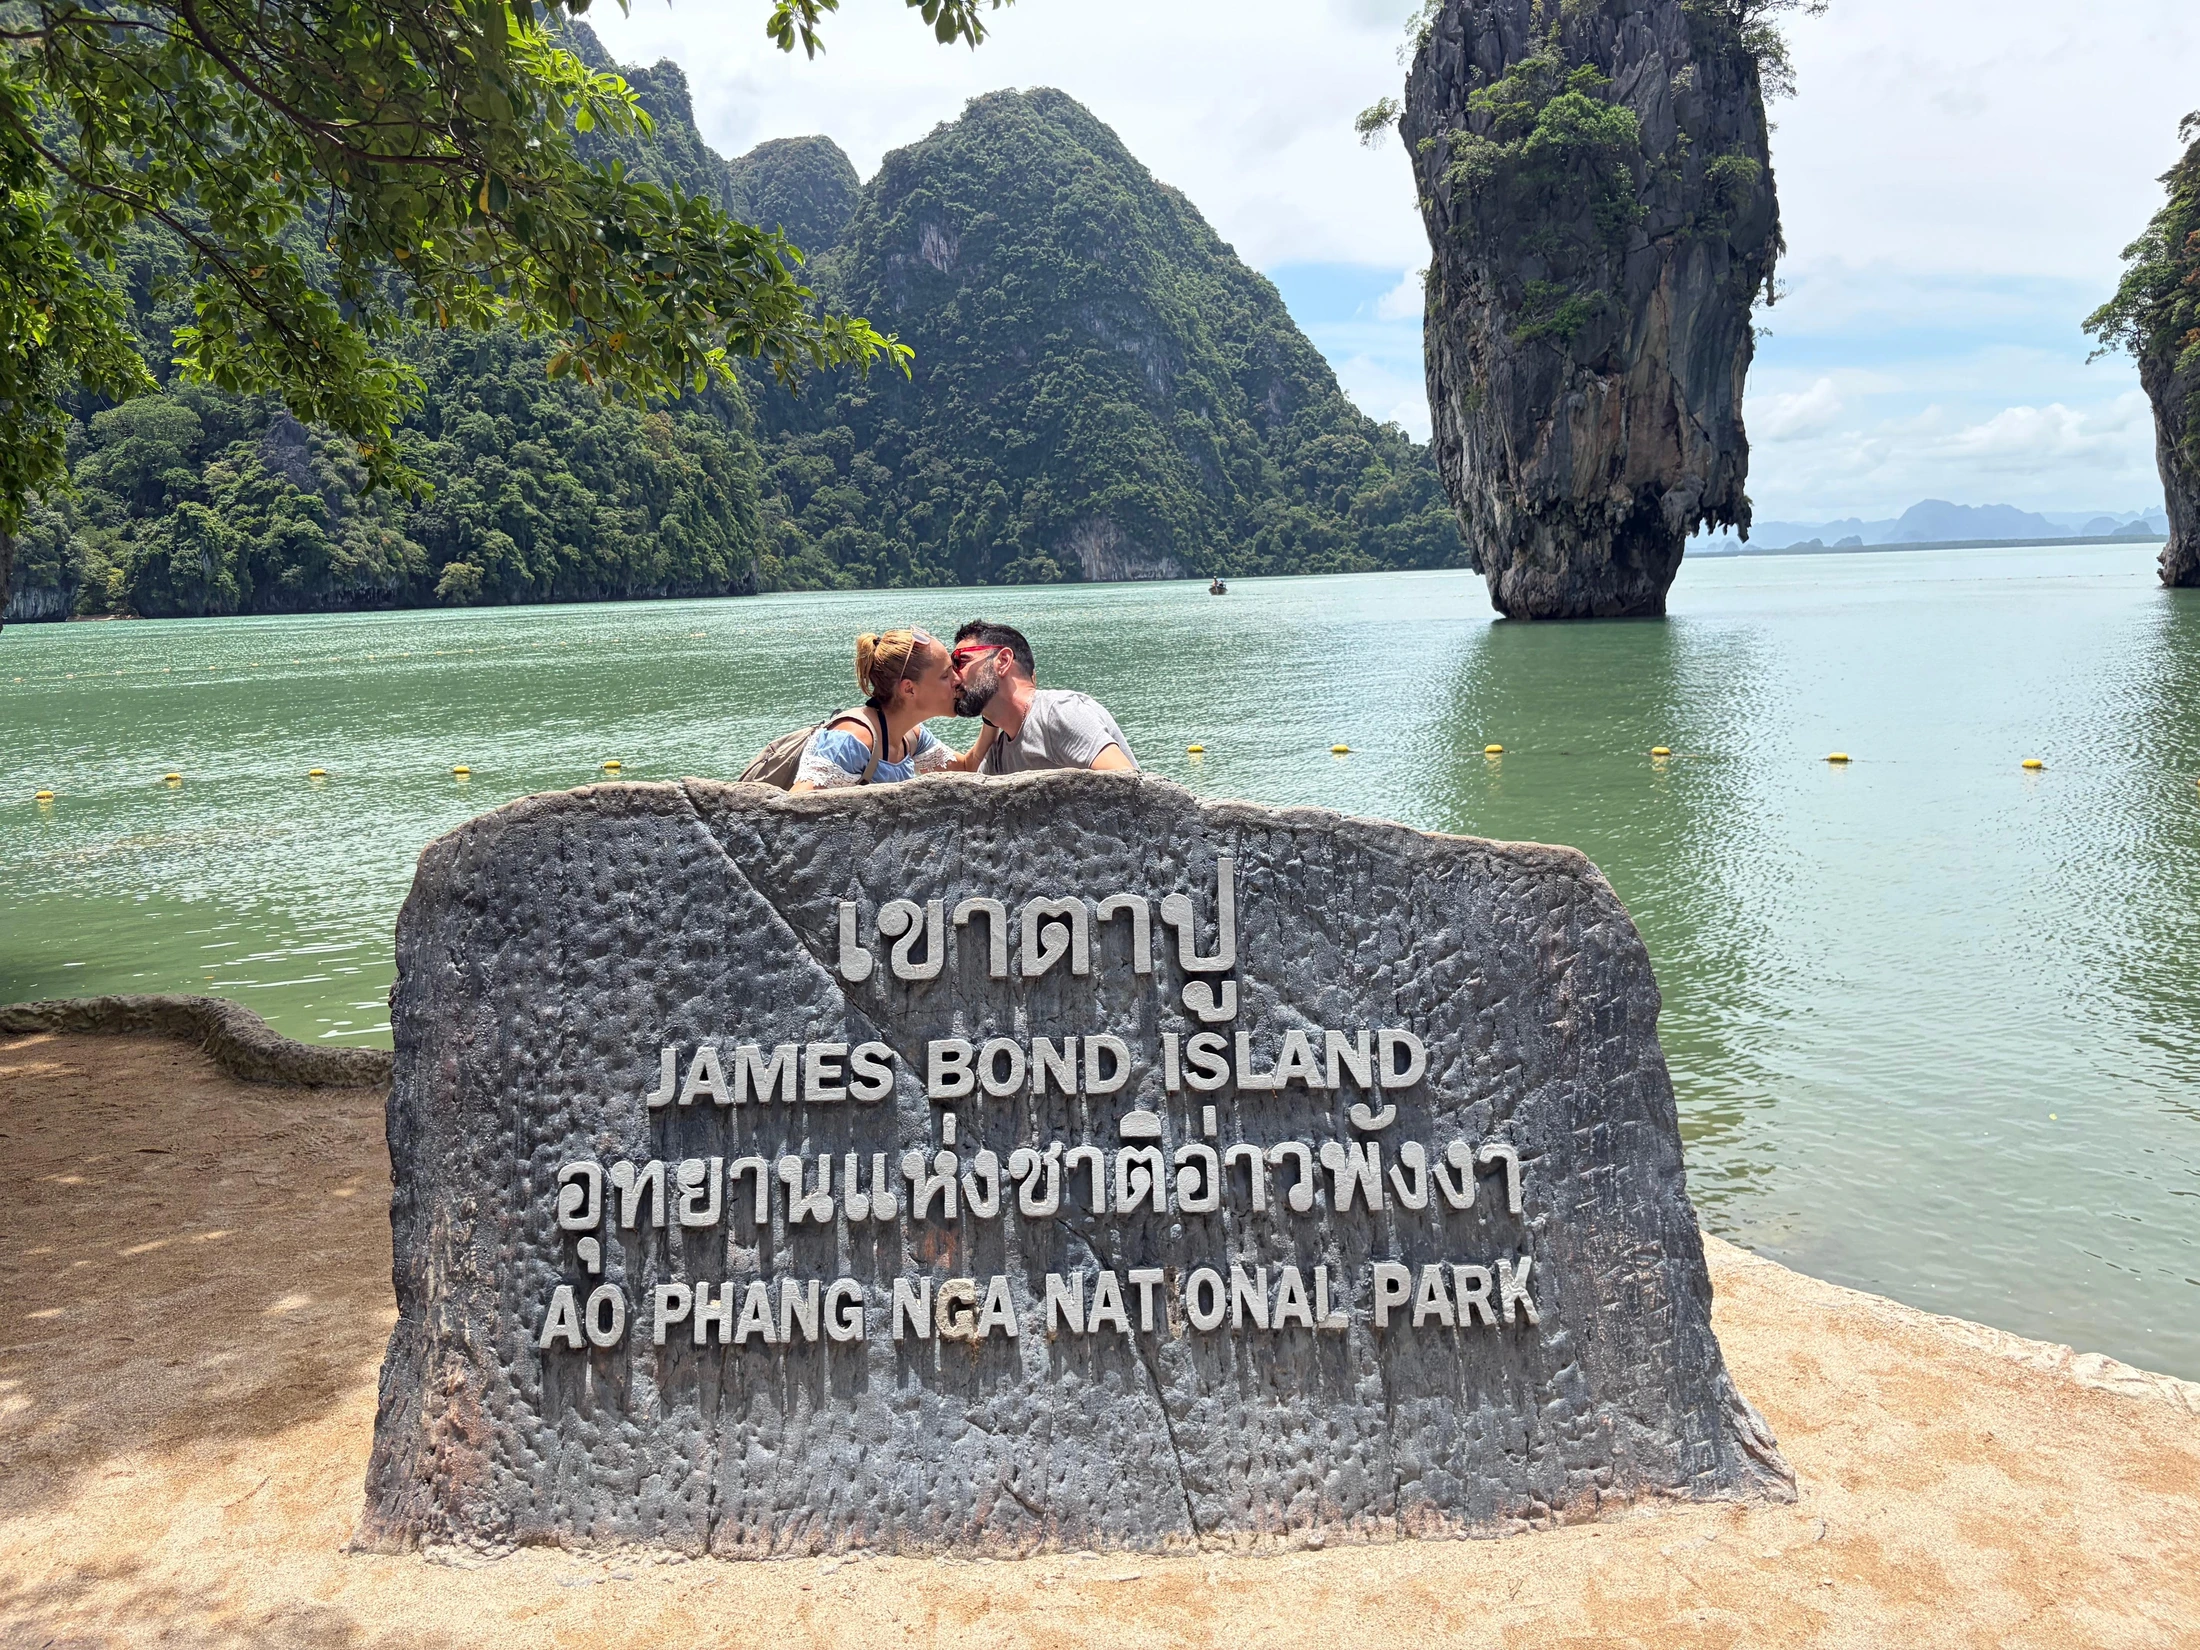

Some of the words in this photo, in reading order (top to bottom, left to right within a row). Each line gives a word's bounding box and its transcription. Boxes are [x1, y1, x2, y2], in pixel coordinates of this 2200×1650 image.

[839, 857, 1237, 1022] เขาตาปู
[647, 1041, 894, 1108] JAMES
[928, 1034, 1132, 1099] BOND
[1162, 1029, 1427, 1092] ISLAND
[557, 1103, 1523, 1274] อุทยานแห่งชาติอ่าวพังงา
[539, 1283, 626, 1350] AO
[653, 1278, 864, 1346] PHANG
[893, 1275, 1019, 1340] NGA
[1045, 1265, 1350, 1334] NATONAL
[1373, 1256, 1541, 1328] PARK
